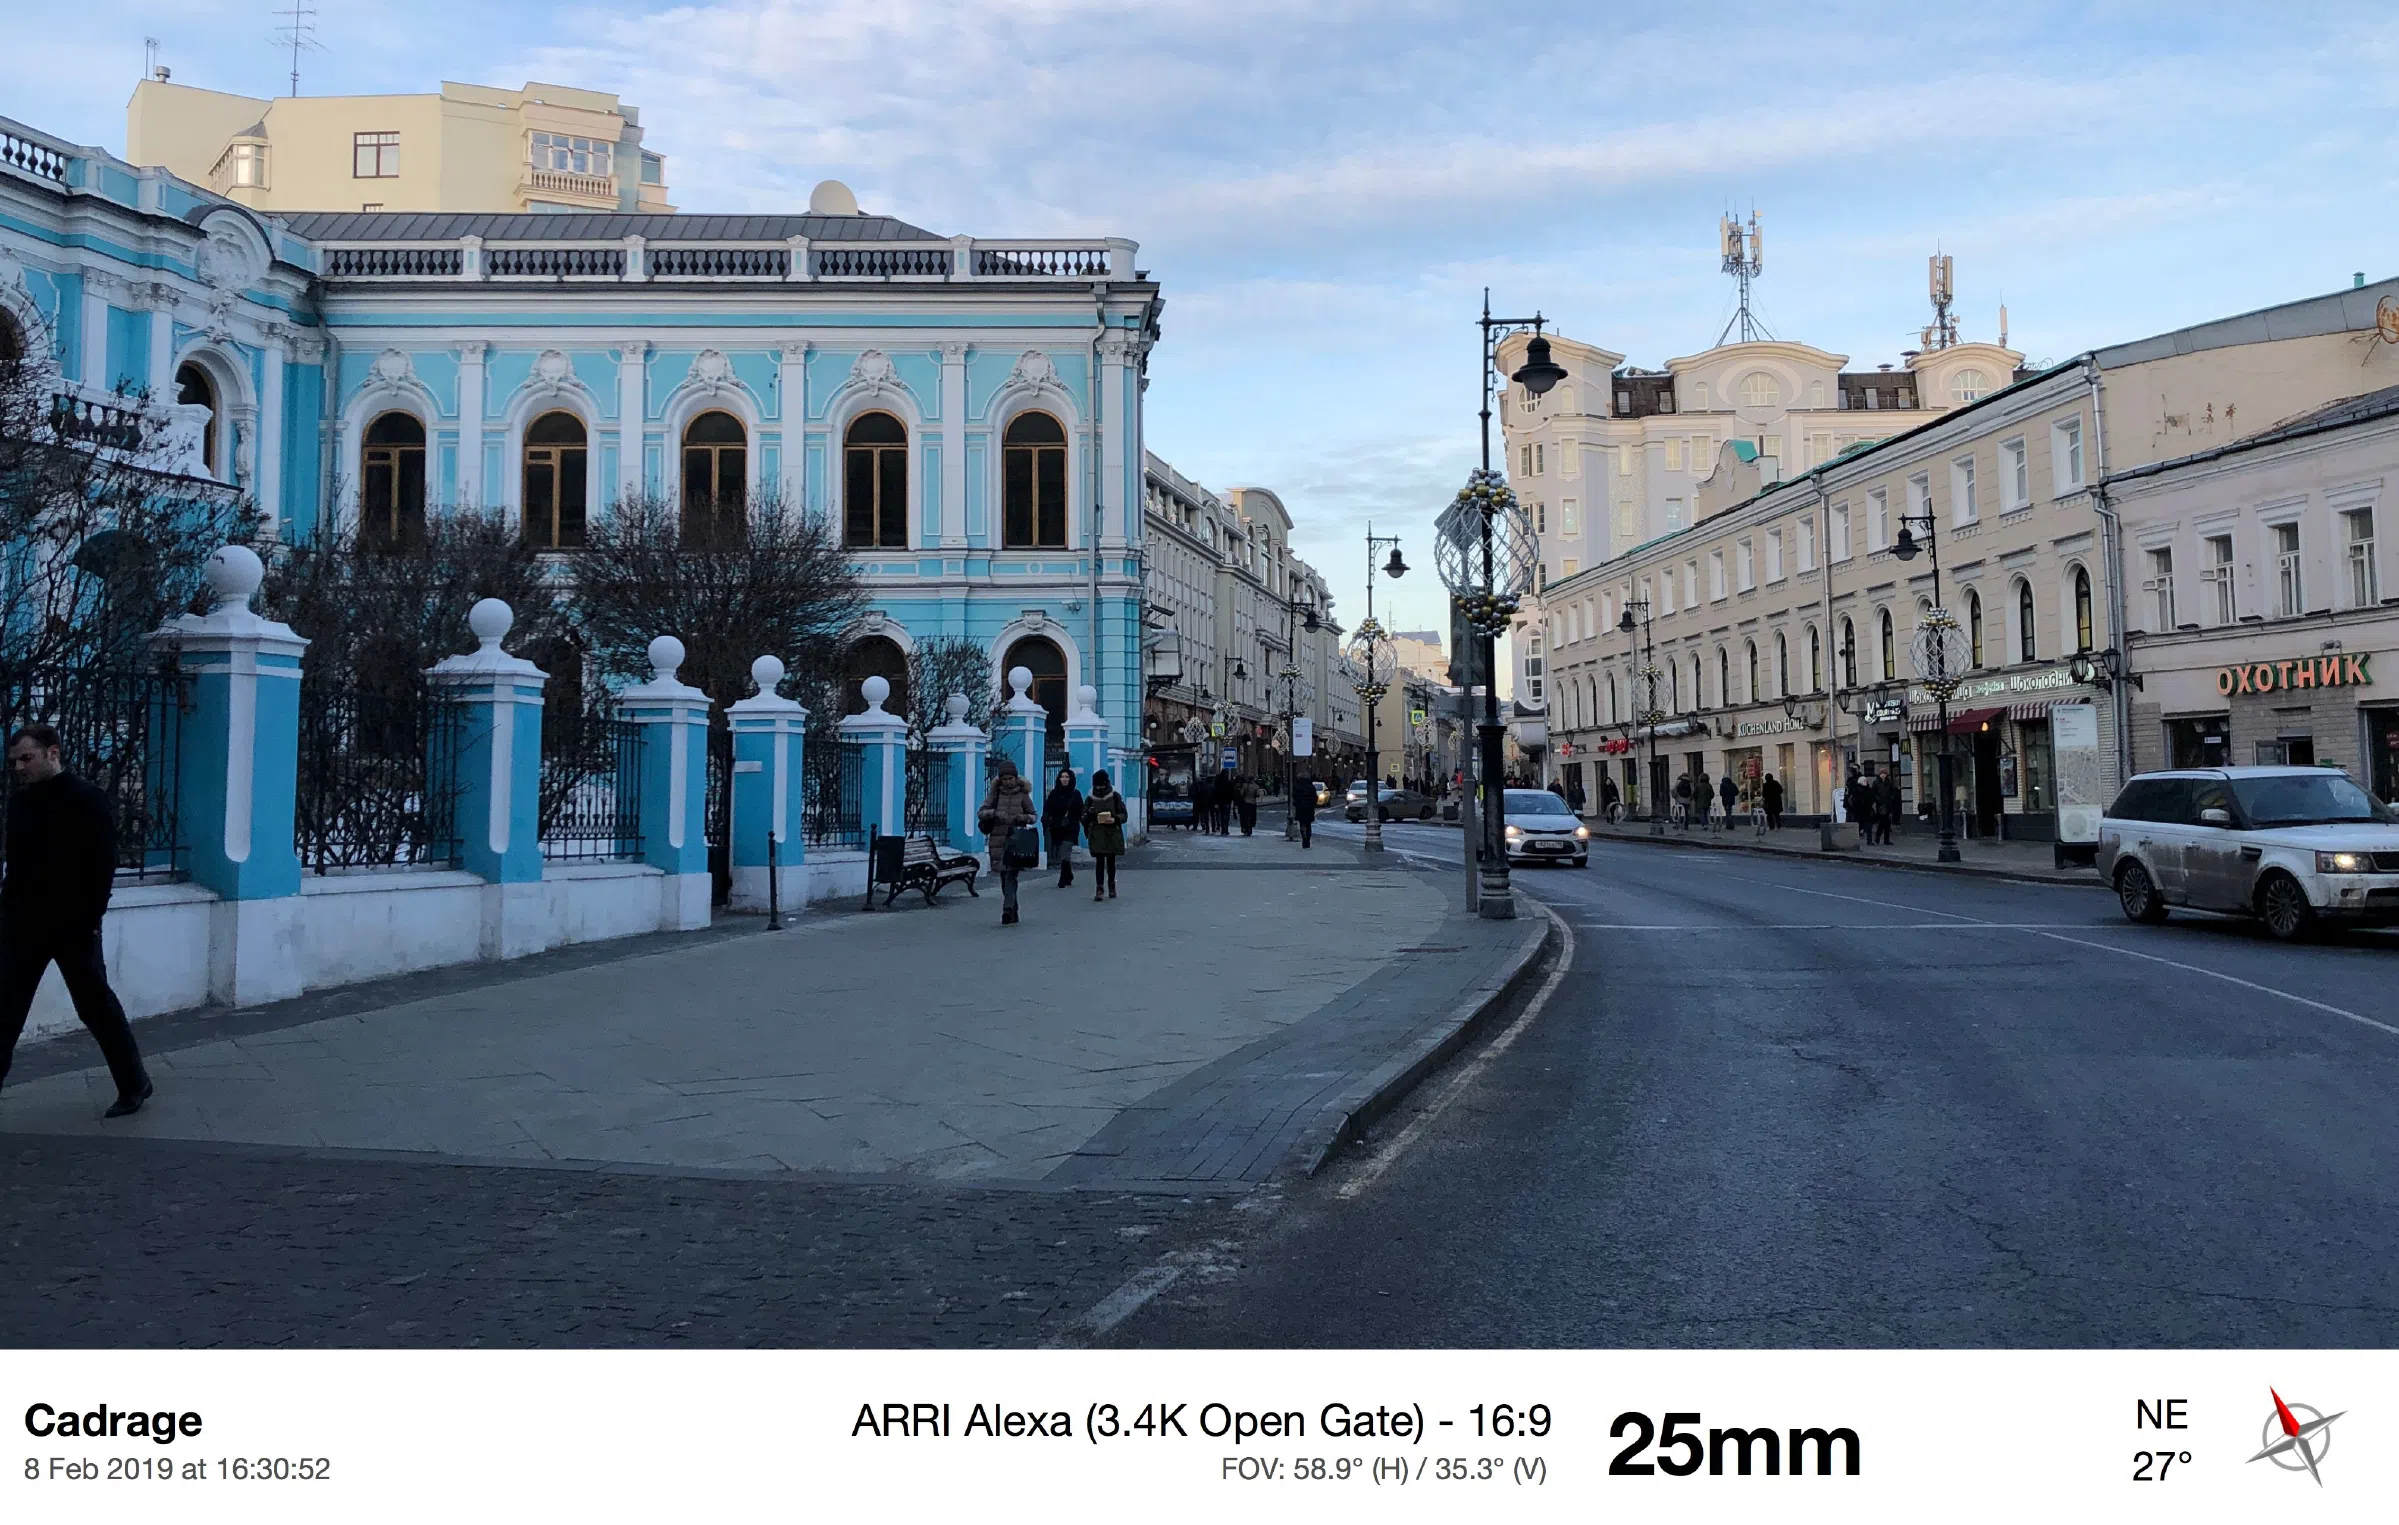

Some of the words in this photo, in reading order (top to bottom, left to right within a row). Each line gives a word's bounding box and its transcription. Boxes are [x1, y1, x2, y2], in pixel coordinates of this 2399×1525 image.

[1909, 685, 1973, 704] Шоколица
[2010, 670, 2081, 692] Шоколадни
[2216, 653, 2372, 696] ОХОТНИК
